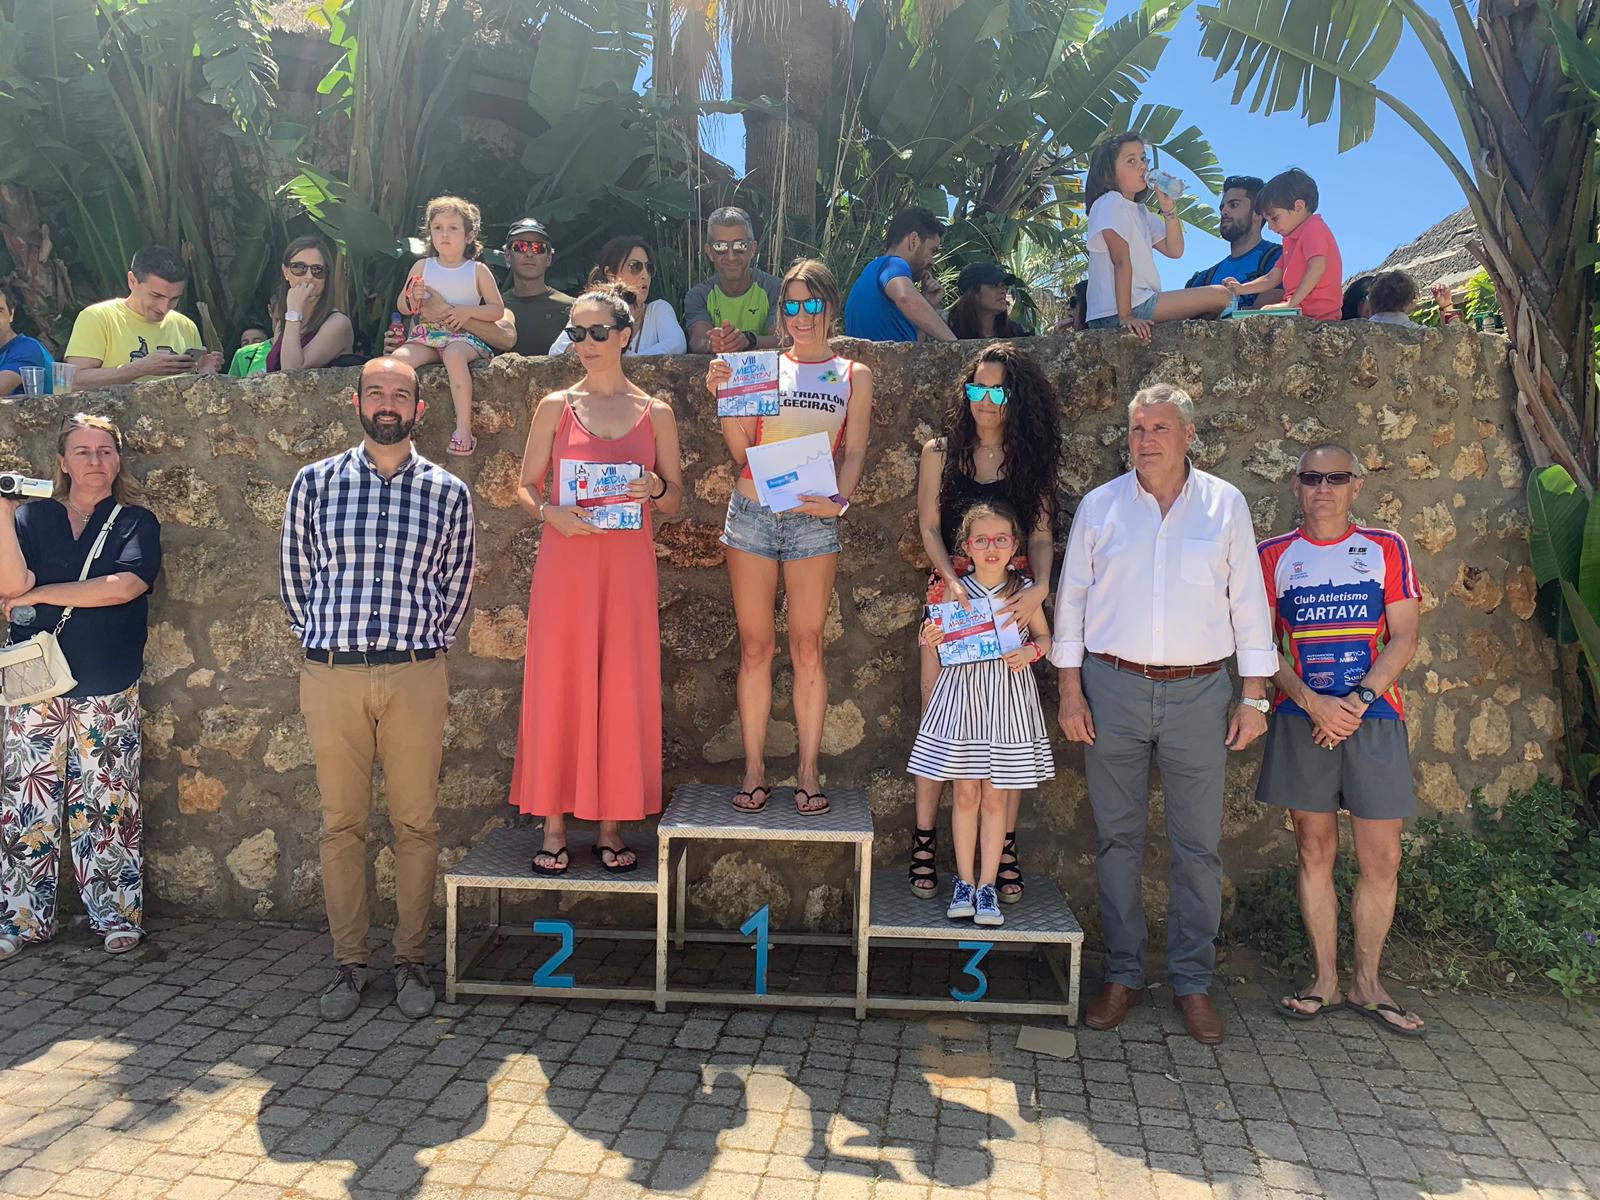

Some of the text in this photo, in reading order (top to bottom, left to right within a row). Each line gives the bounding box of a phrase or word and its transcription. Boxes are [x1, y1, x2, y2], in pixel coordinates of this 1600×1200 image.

[742, 355, 756, 366] VIII
[735, 363, 766, 376] MEDIA
[791, 390, 845, 407] TRIATLÓN
[601, 466, 617, 476] VIII
[595, 475, 628, 486] MEDIA
[1294, 591, 1369, 605] Club Atletismo
[1295, 604, 1368, 622] CARTAYA
[532, 919, 575, 988] 2
[740, 903, 770, 995] 1
[949, 940, 994, 1002] 3
